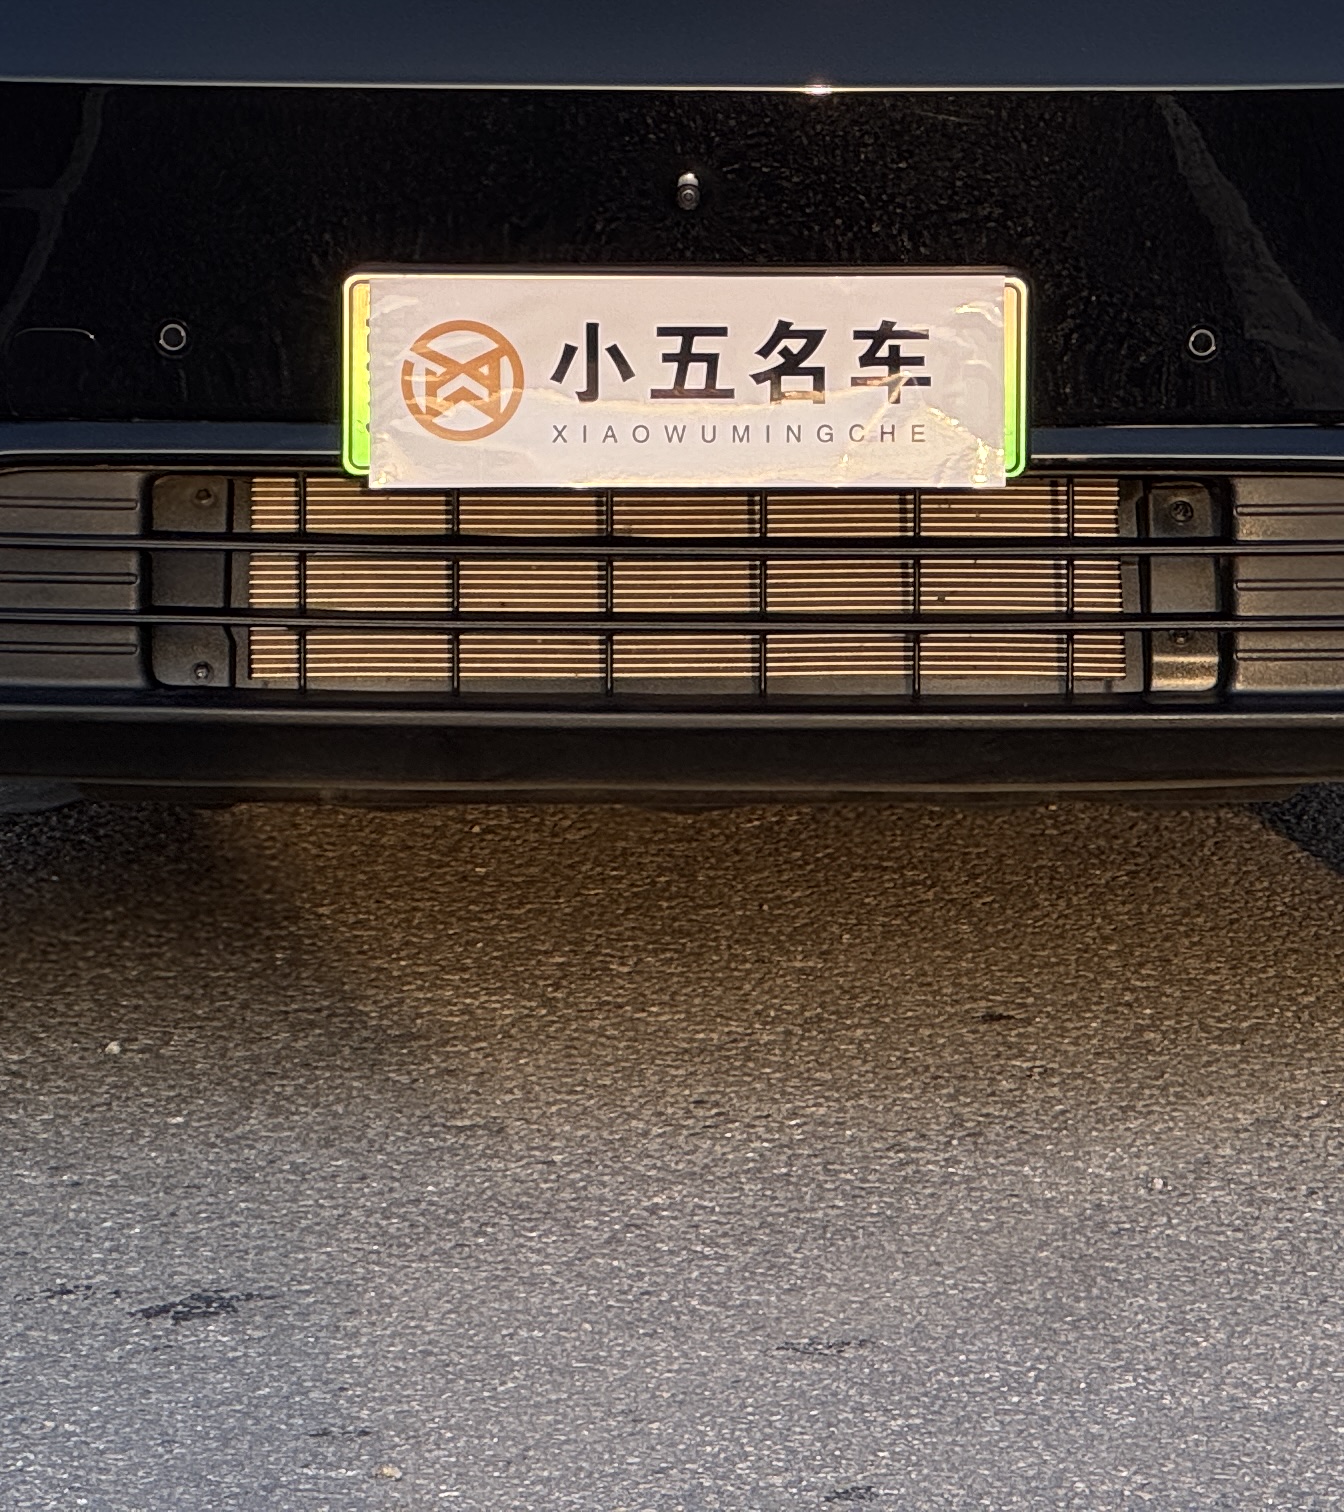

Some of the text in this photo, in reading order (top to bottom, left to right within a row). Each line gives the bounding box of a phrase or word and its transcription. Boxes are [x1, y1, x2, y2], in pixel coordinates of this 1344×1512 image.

[549, 320, 932, 405] 小五名车
[552, 424, 927, 444] XIAOWUMINGCHE
